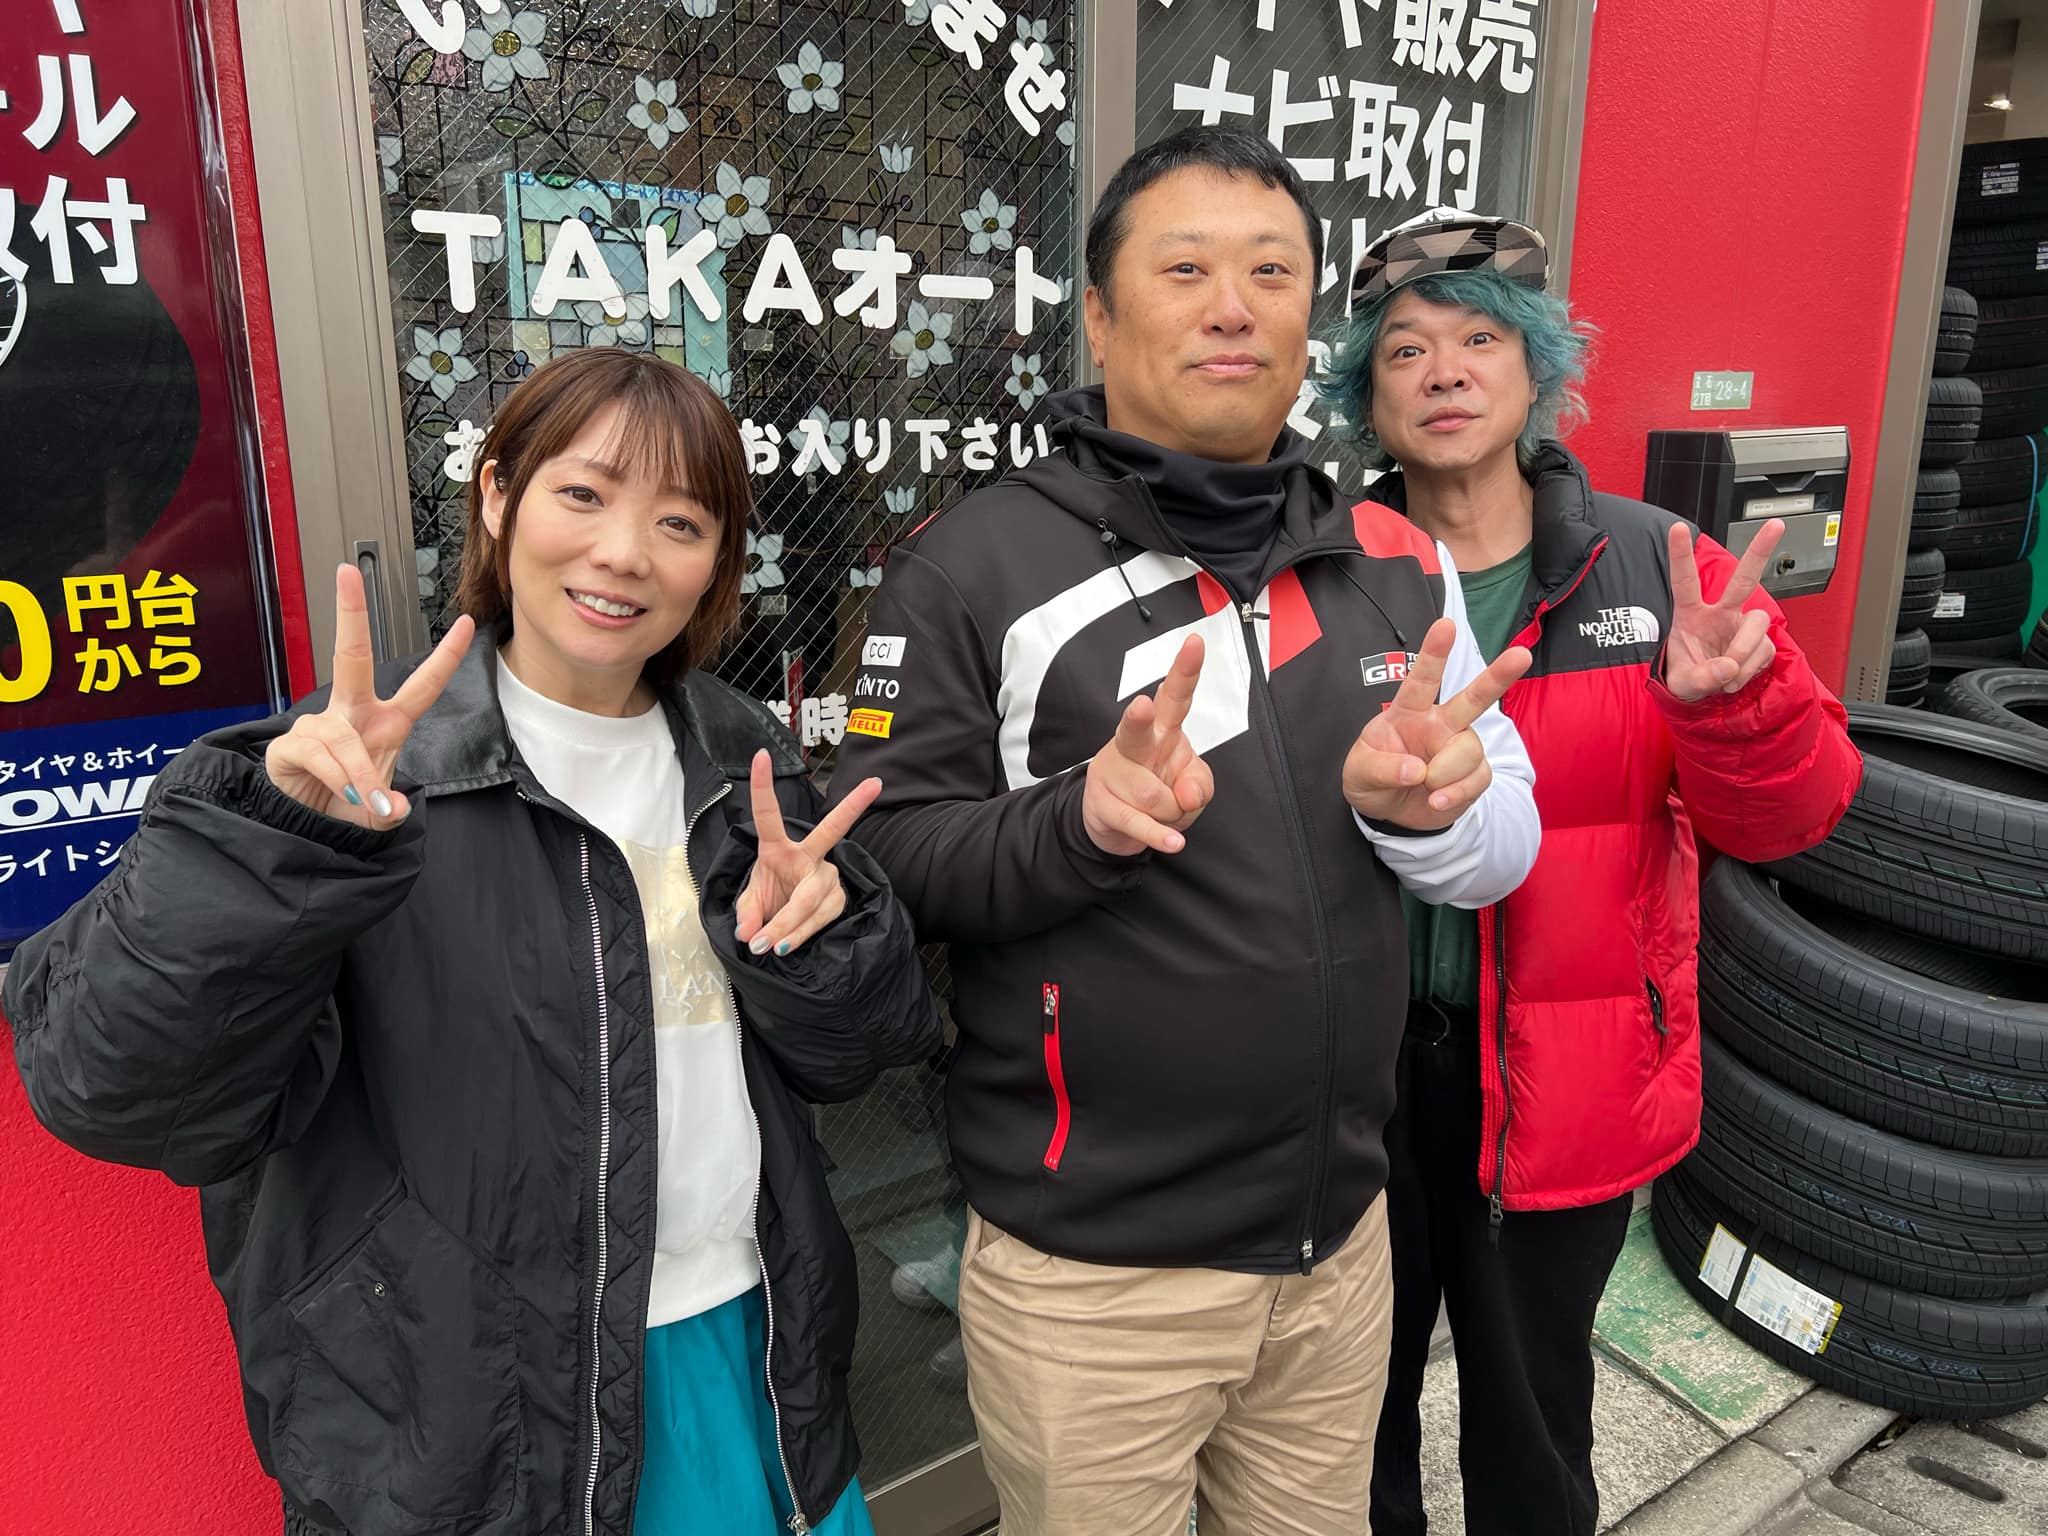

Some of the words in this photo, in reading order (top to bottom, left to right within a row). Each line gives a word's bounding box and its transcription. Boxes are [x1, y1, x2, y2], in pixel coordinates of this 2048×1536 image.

[0, 54, 137, 156] ル
[1173, 55, 1485, 211] ナビ取付
[410, 209, 1062, 336] TAKAオート
[738, 416, 1049, 477] お入り下さい
[62, 570, 199, 634] 円台
[1578, 618, 1633, 637] NORTH
[1597, 606, 1631, 622] THE
[75, 634, 202, 695] から
[1596, 631, 1635, 648] FACE
[1365, 664, 1406, 683] GR
[0, 738, 197, 785] タイヤ&ホイー
